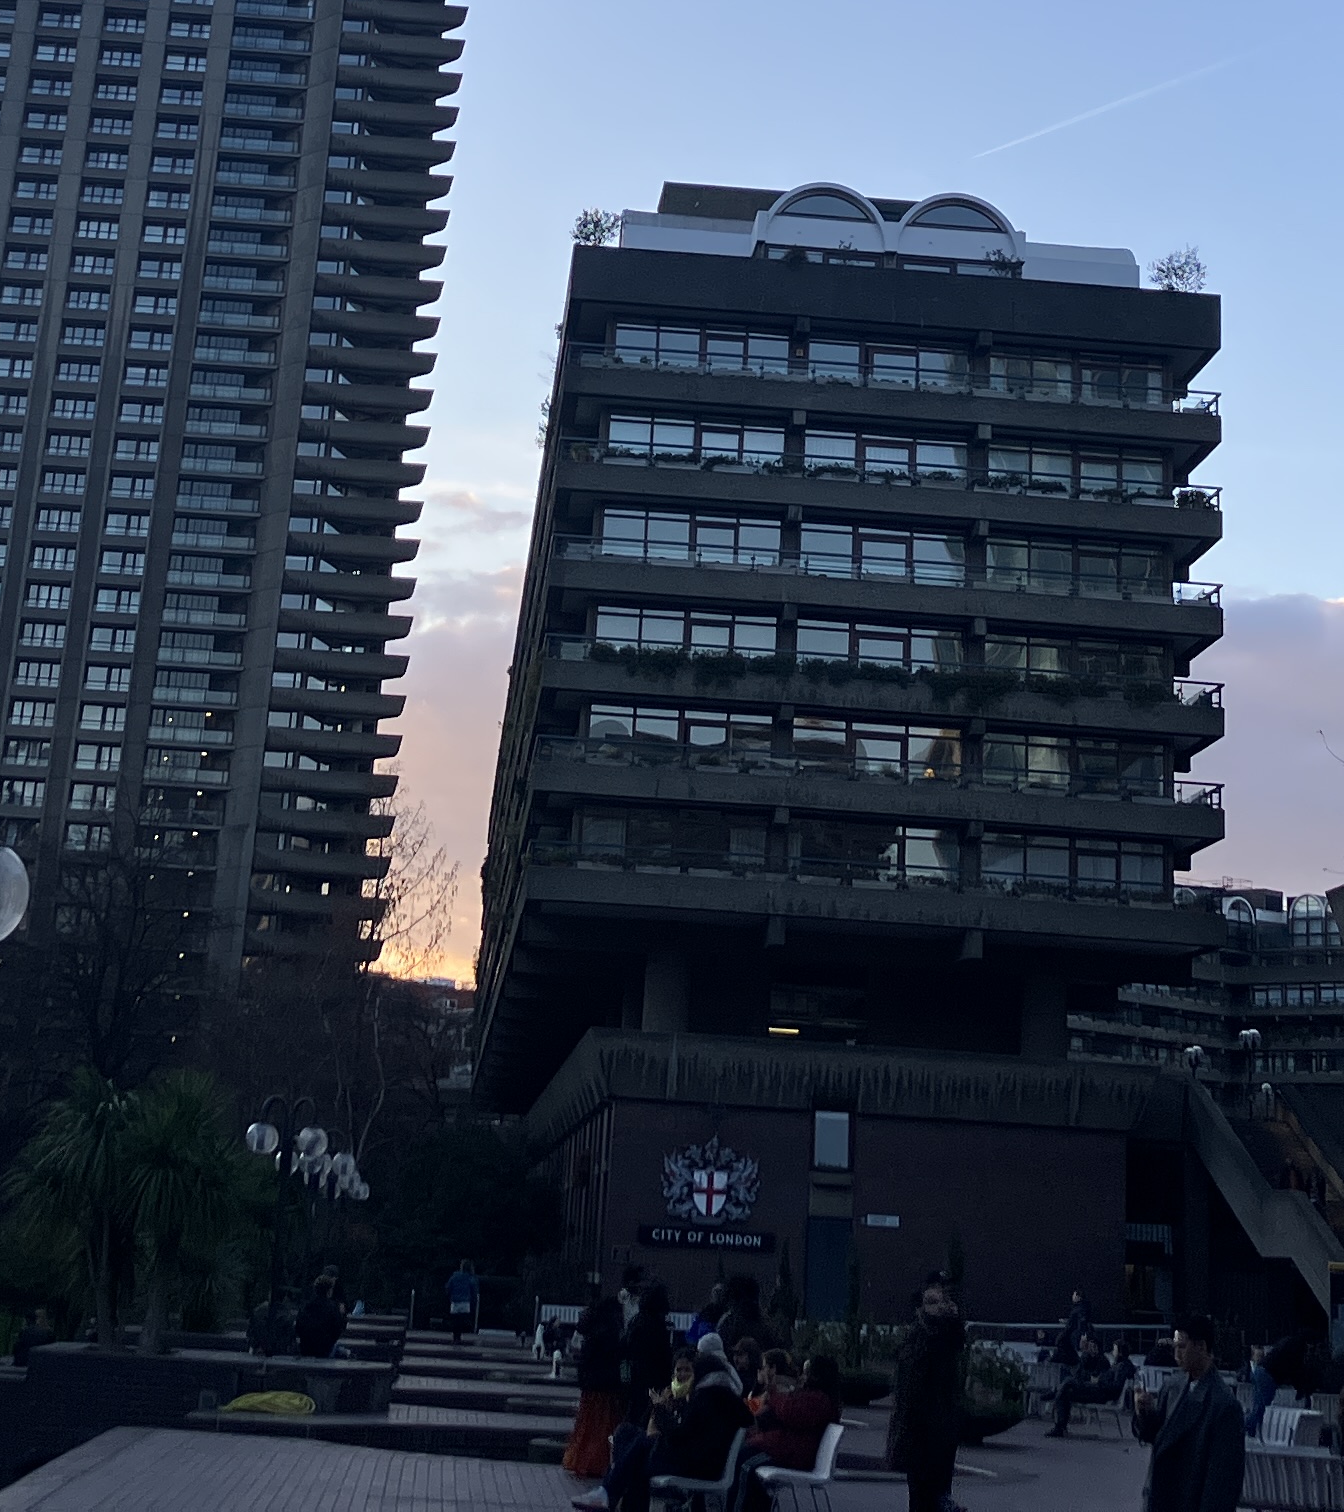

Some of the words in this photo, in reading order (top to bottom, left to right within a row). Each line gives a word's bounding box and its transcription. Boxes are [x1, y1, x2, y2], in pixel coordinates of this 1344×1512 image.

[651, 1227, 681, 1243] CITY
[687, 1228, 704, 1243] OF
[709, 1231, 762, 1248] LONDON
